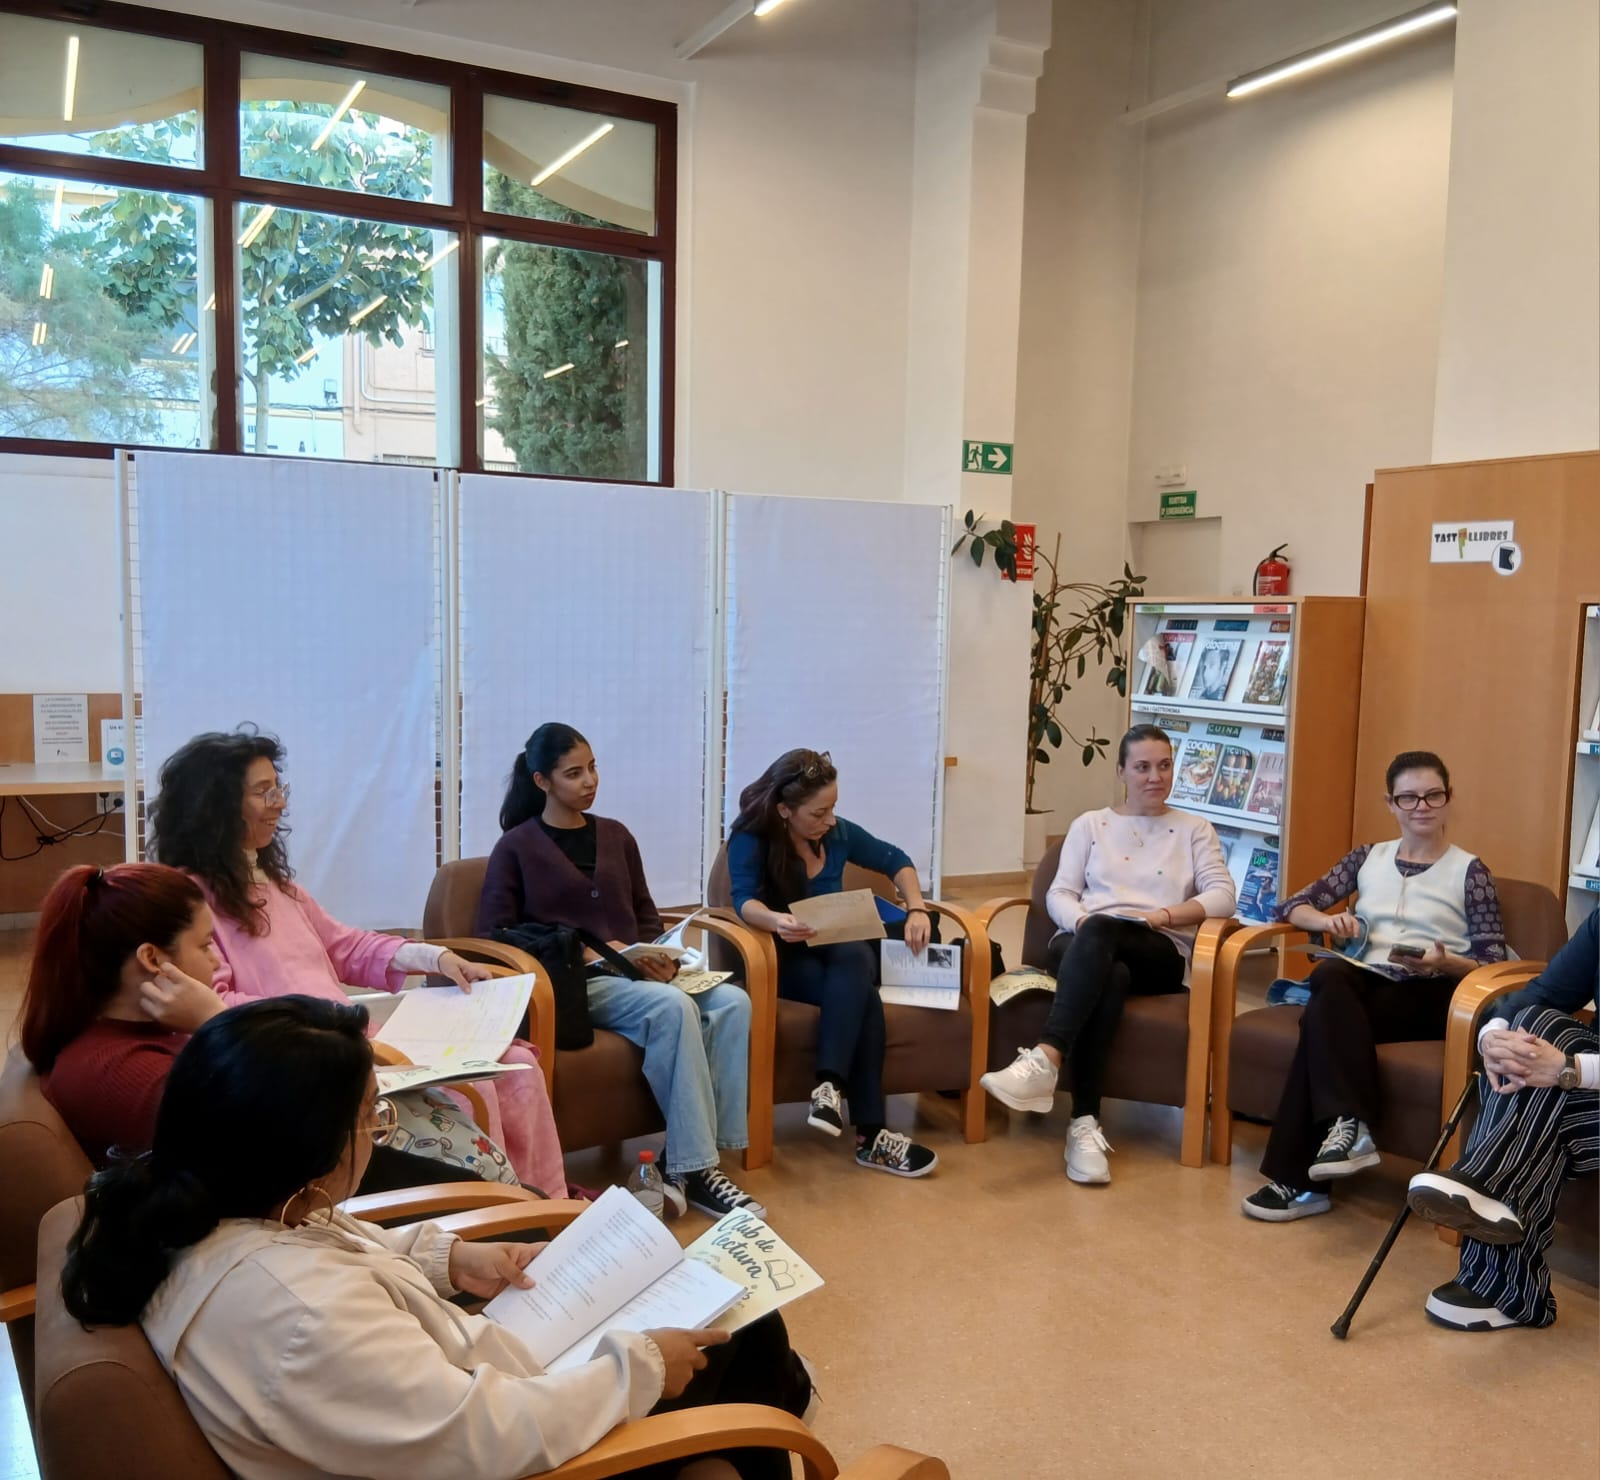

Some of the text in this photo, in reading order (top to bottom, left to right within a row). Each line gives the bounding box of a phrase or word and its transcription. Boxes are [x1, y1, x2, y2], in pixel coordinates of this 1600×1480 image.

[1434, 533, 1458, 543] TAST
[1468, 531, 1508, 541] LLIBRES
[1208, 725, 1240, 736] CUINA
[1186, 740, 1216, 752] COCINA
[717, 1214, 776, 1253] Club de
[711, 1231, 762, 1279] lectura
